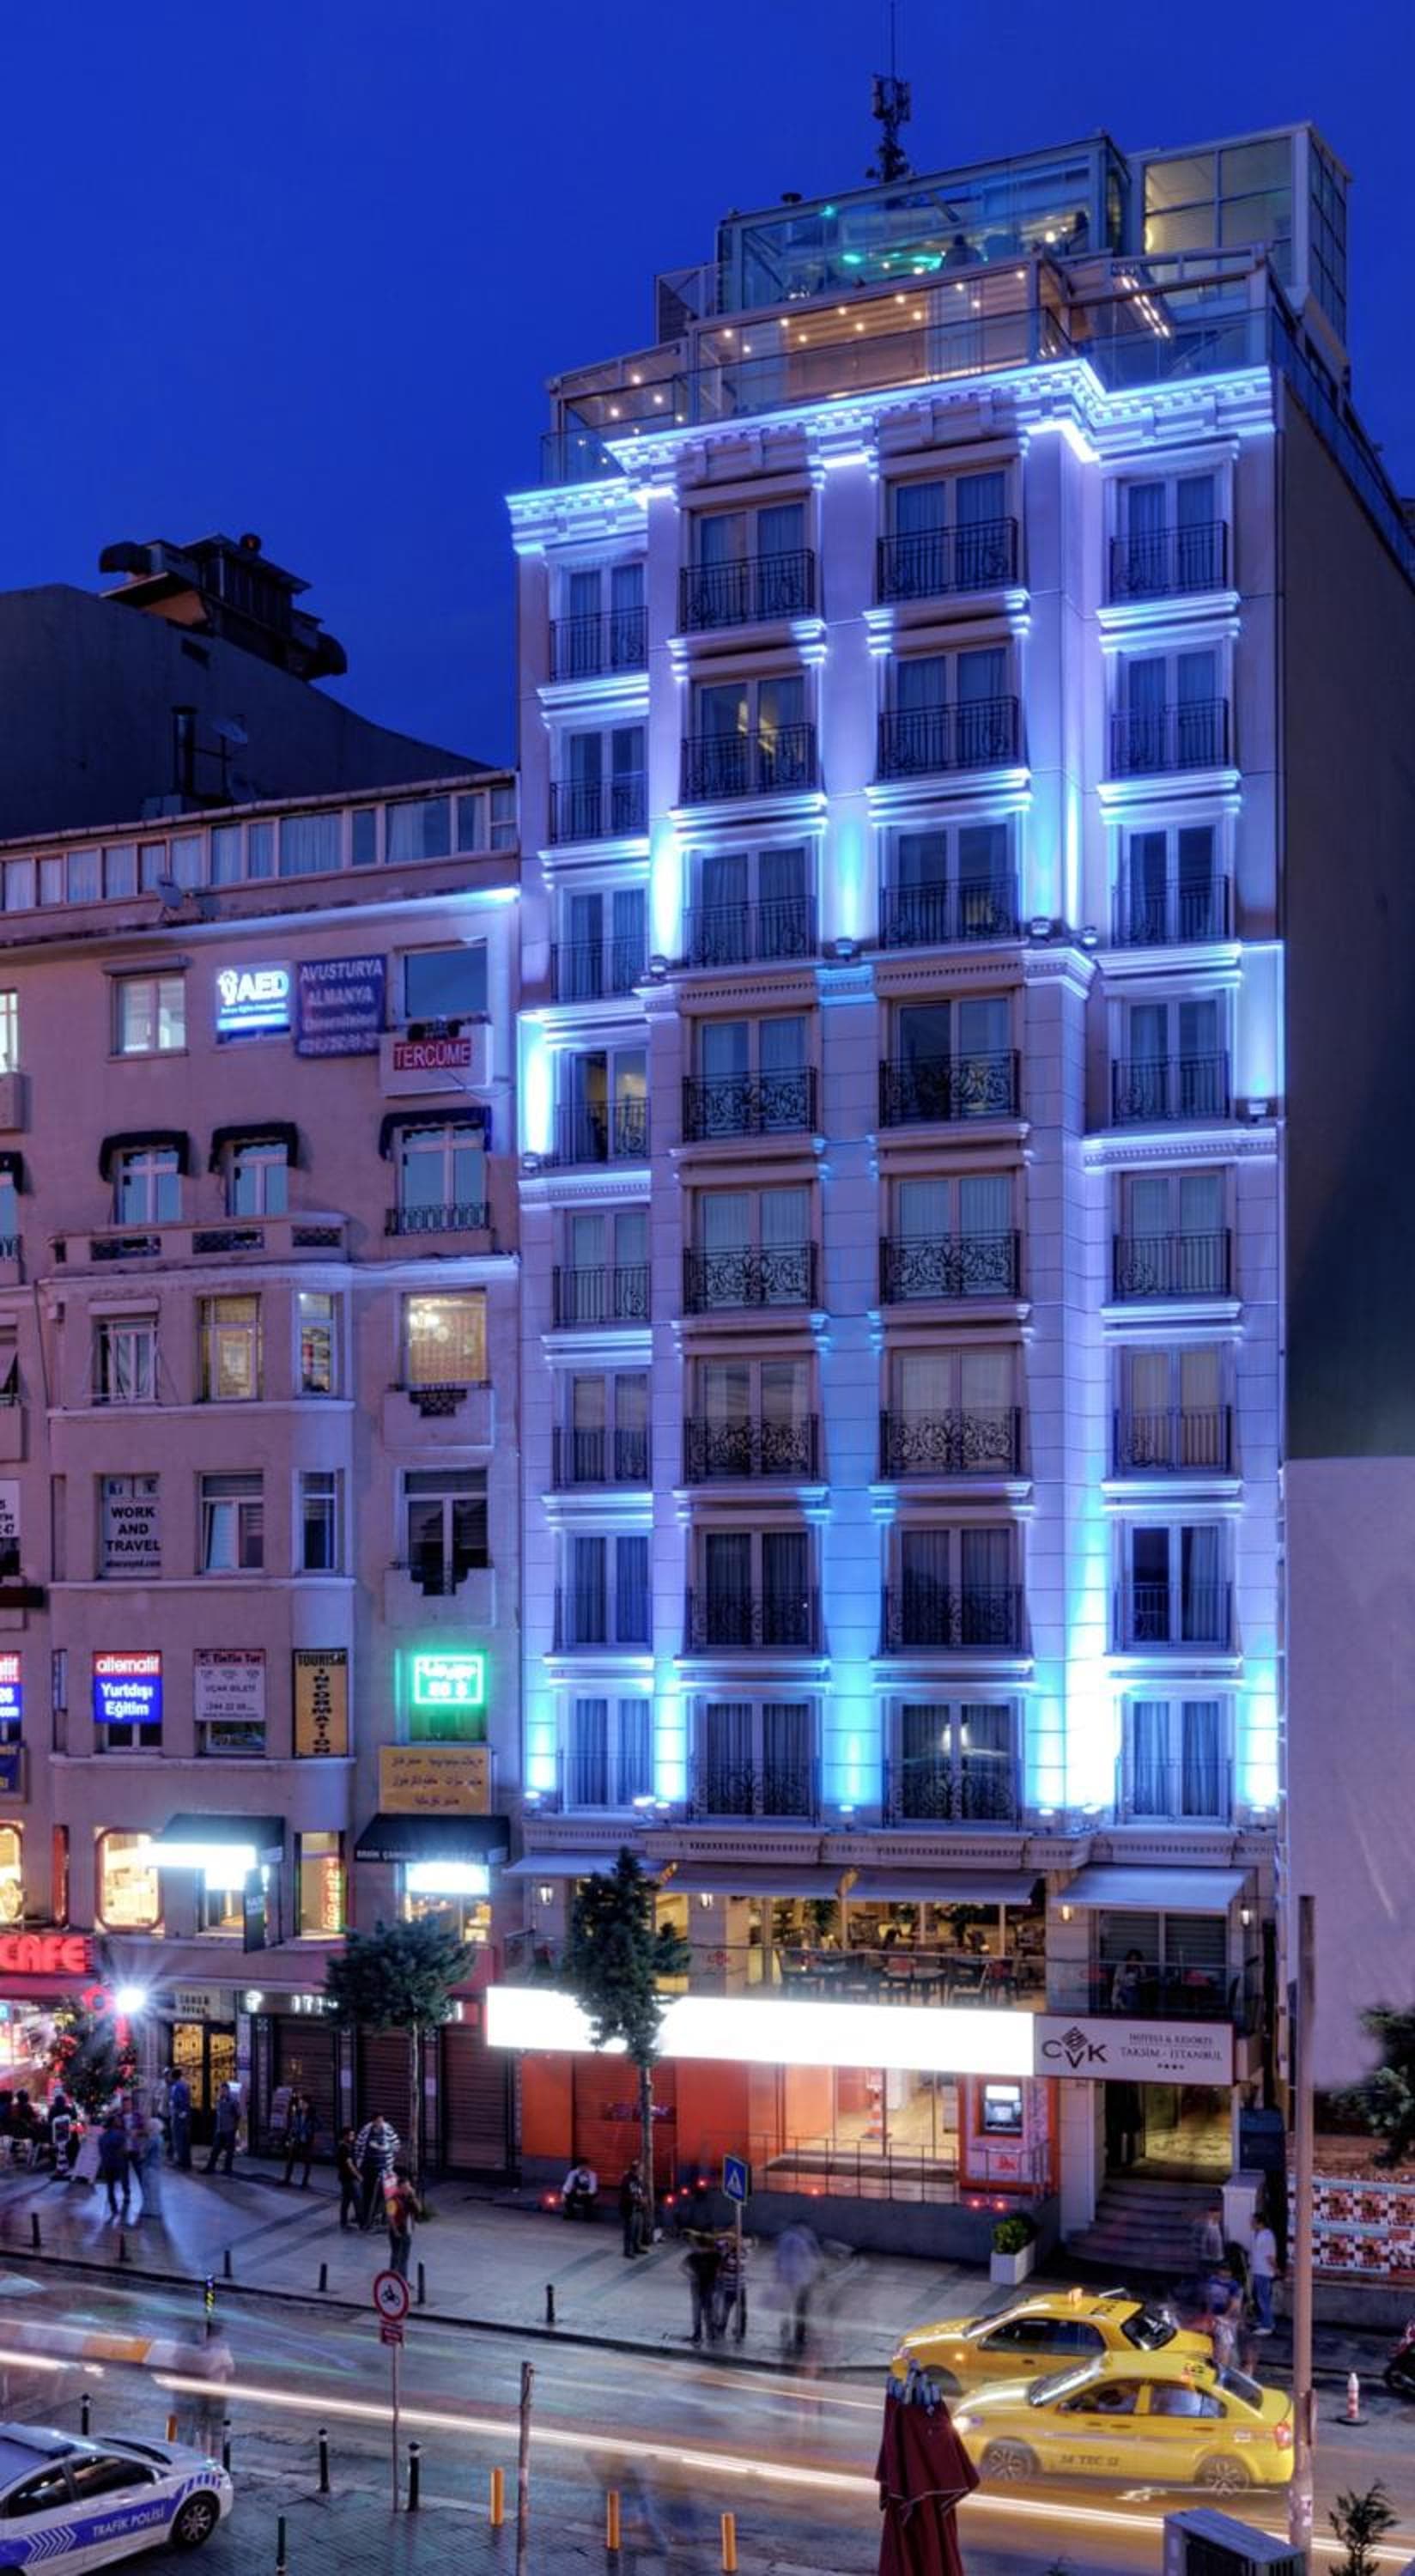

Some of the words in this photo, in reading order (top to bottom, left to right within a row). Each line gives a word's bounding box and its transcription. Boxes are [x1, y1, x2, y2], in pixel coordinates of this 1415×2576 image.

[301, 959, 384, 982] AVUSTURYA
[236, 969, 288, 1002] AED
[308, 986, 373, 1006] ALMANYA
[395, 1042, 471, 1068] TERCÜME
[111, 1506, 155, 1518] WORK
[118, 1523, 149, 1534] AND
[105, 1540, 161, 1552] TRAVEL
[106, 1700, 150, 1719] Eğitim
[0, 1935, 84, 1972] CAFE
[1042, 2039, 1108, 2069] CVK
